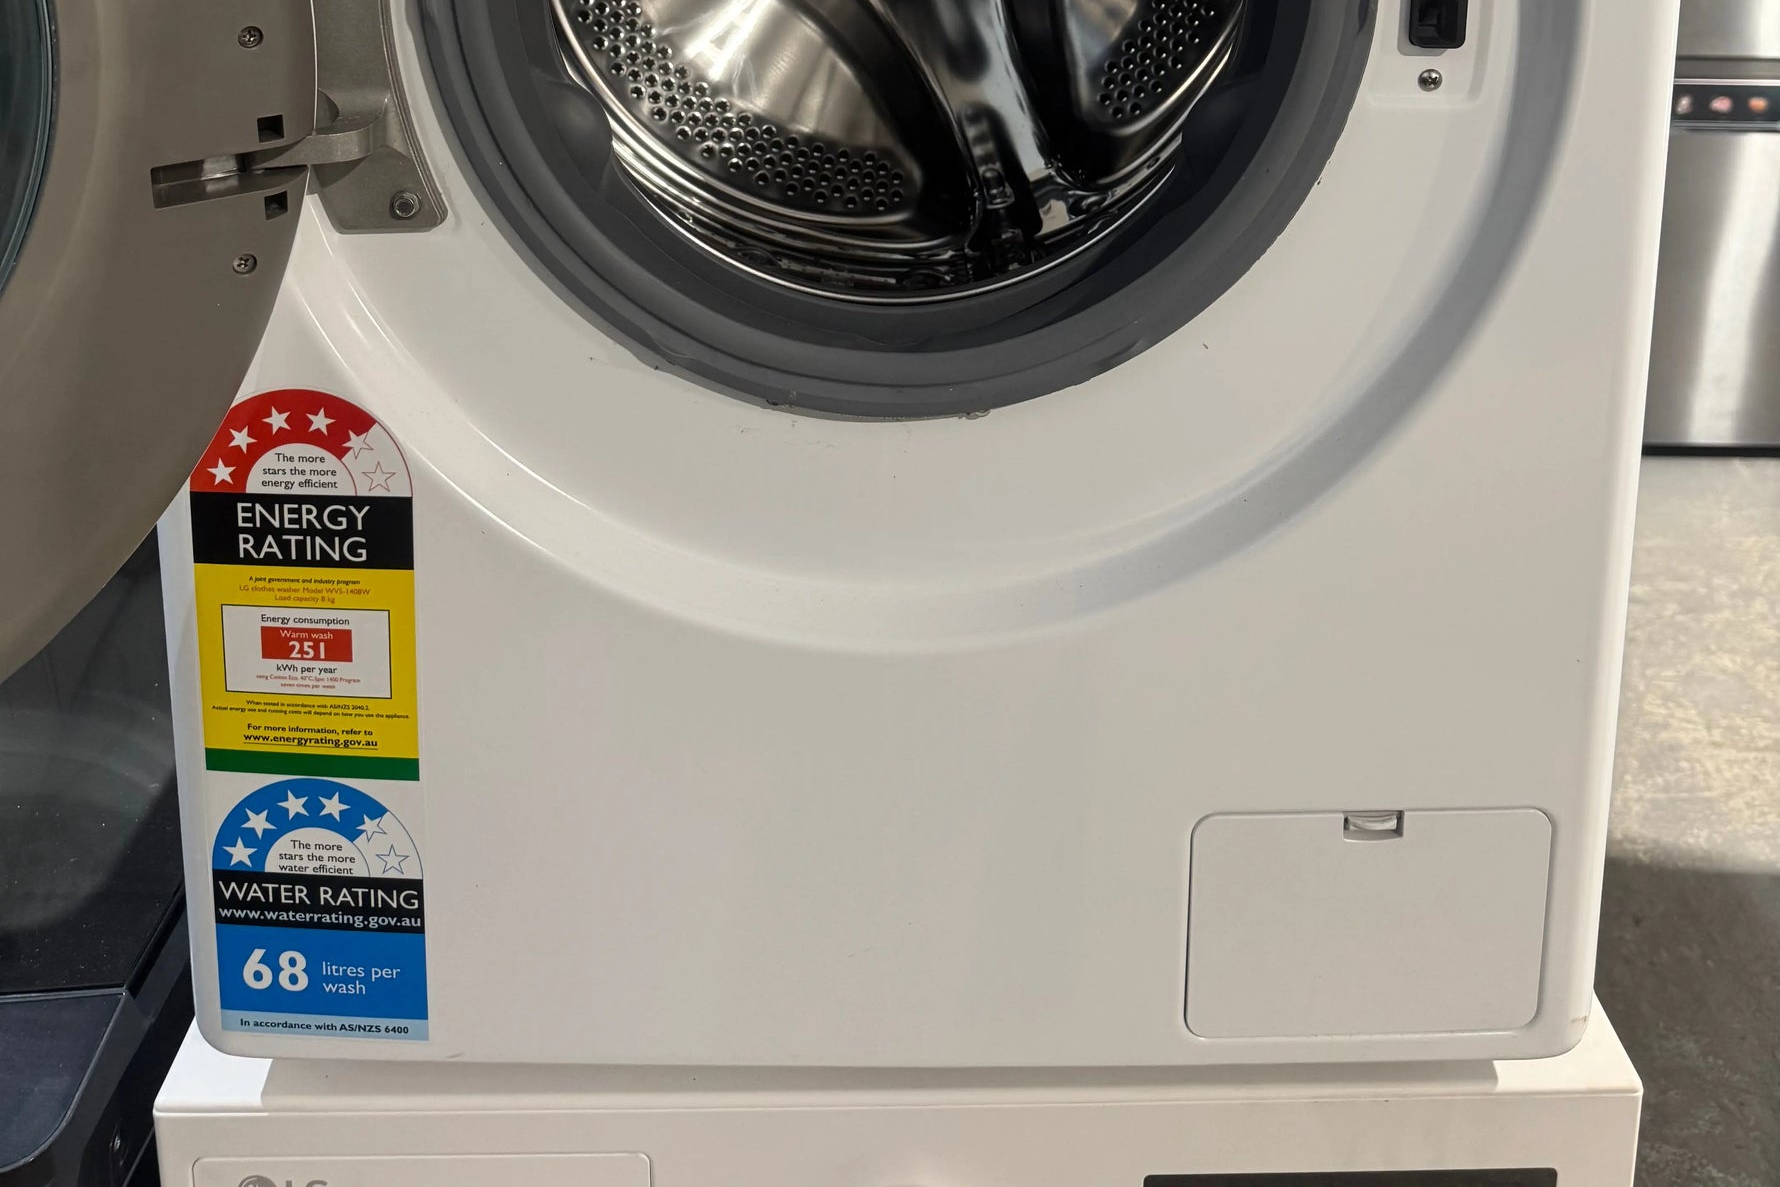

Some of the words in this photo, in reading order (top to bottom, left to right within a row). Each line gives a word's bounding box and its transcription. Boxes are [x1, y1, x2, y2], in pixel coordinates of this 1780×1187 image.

[274, 453, 295, 463] The
[298, 454, 326, 463] more
[262, 467, 287, 476] stars
[290, 467, 307, 476] the
[309, 468, 337, 477] more
[261, 479, 295, 490] energy
[298, 479, 339, 489] efficient
[237, 502, 371, 531] ENERGY
[238, 533, 368, 562] RATING
[302, 586, 324, 594] Model
[261, 614, 291, 626] Energy
[293, 617, 350, 627] consumption
[279, 629, 309, 639] Warm
[311, 631, 333, 639] wash
[288, 641, 325, 659] 251
[276, 664, 298, 672] kWh
[301, 666, 316, 674] per
[318, 667, 337, 675] year
[247, 722, 262, 731] For
[264, 724, 286, 732] more
[288, 725, 340, 736] information,
[341, 727, 362, 736] refer
[364, 728, 373, 737] to
[243, 733, 378, 748] www.energyrating.gov.au
[290, 839, 311, 850] The
[314, 843, 343, 851] more
[278, 852, 304, 861] stars
[307, 852, 324, 862] the
[327, 855, 356, 863] more
[278, 864, 310, 873] water
[312, 864, 354, 875] efficient
[218, 880, 311, 905] WATER
[319, 885, 419, 910] RATING
[218, 906, 421, 929] www.waterrating.gov.au
[242, 947, 309, 992] 68
[322, 961, 365, 978] litres
[371, 964, 401, 982] per
[322, 979, 366, 995] wash
[240, 1018, 250, 1027] In
[253, 1019, 312, 1030] accordance
[314, 1021, 337, 1031] with
[339, 1023, 382, 1033] AS/NZS
[384, 1025, 409, 1034] 6400
